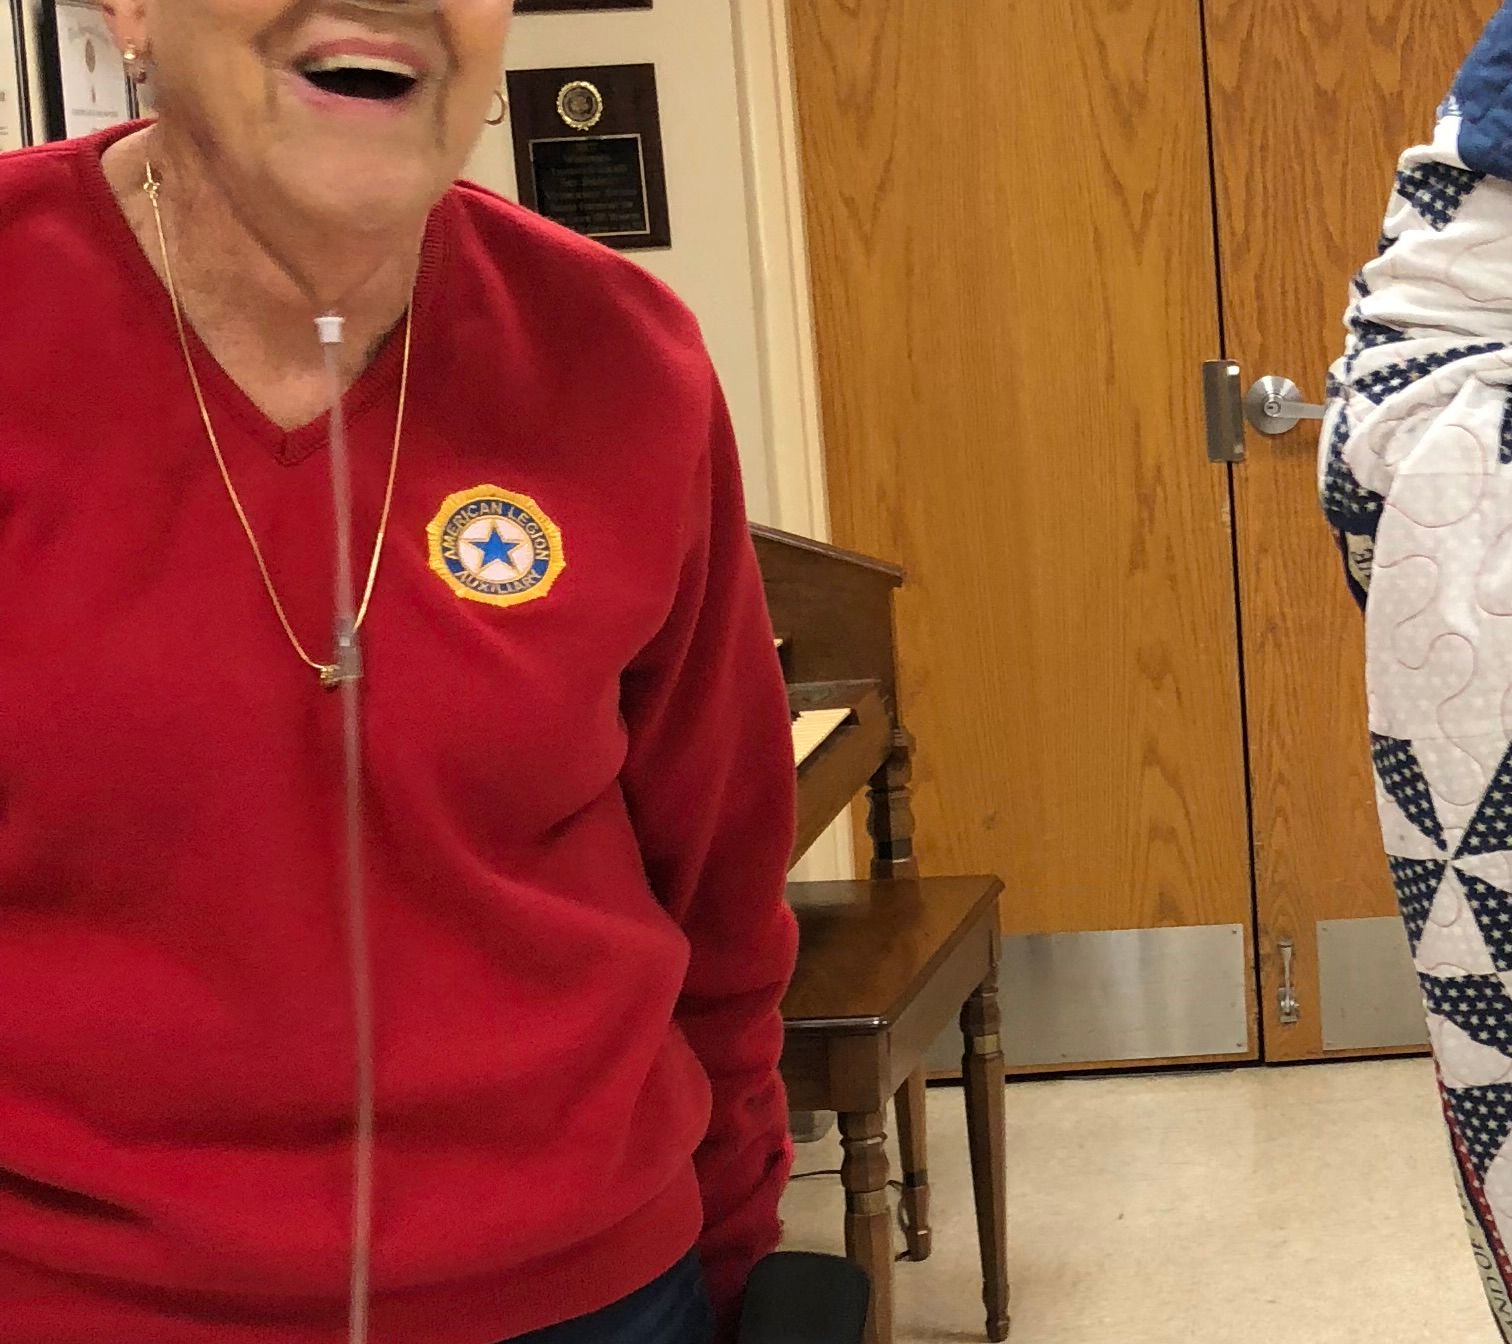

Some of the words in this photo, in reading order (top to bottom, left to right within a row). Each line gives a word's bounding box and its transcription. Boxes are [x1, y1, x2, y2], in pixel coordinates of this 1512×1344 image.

[443, 502, 503, 560] AMERICAN
[507, 506, 550, 560] LEGION
[454, 569, 543, 593] AUXILIARY
